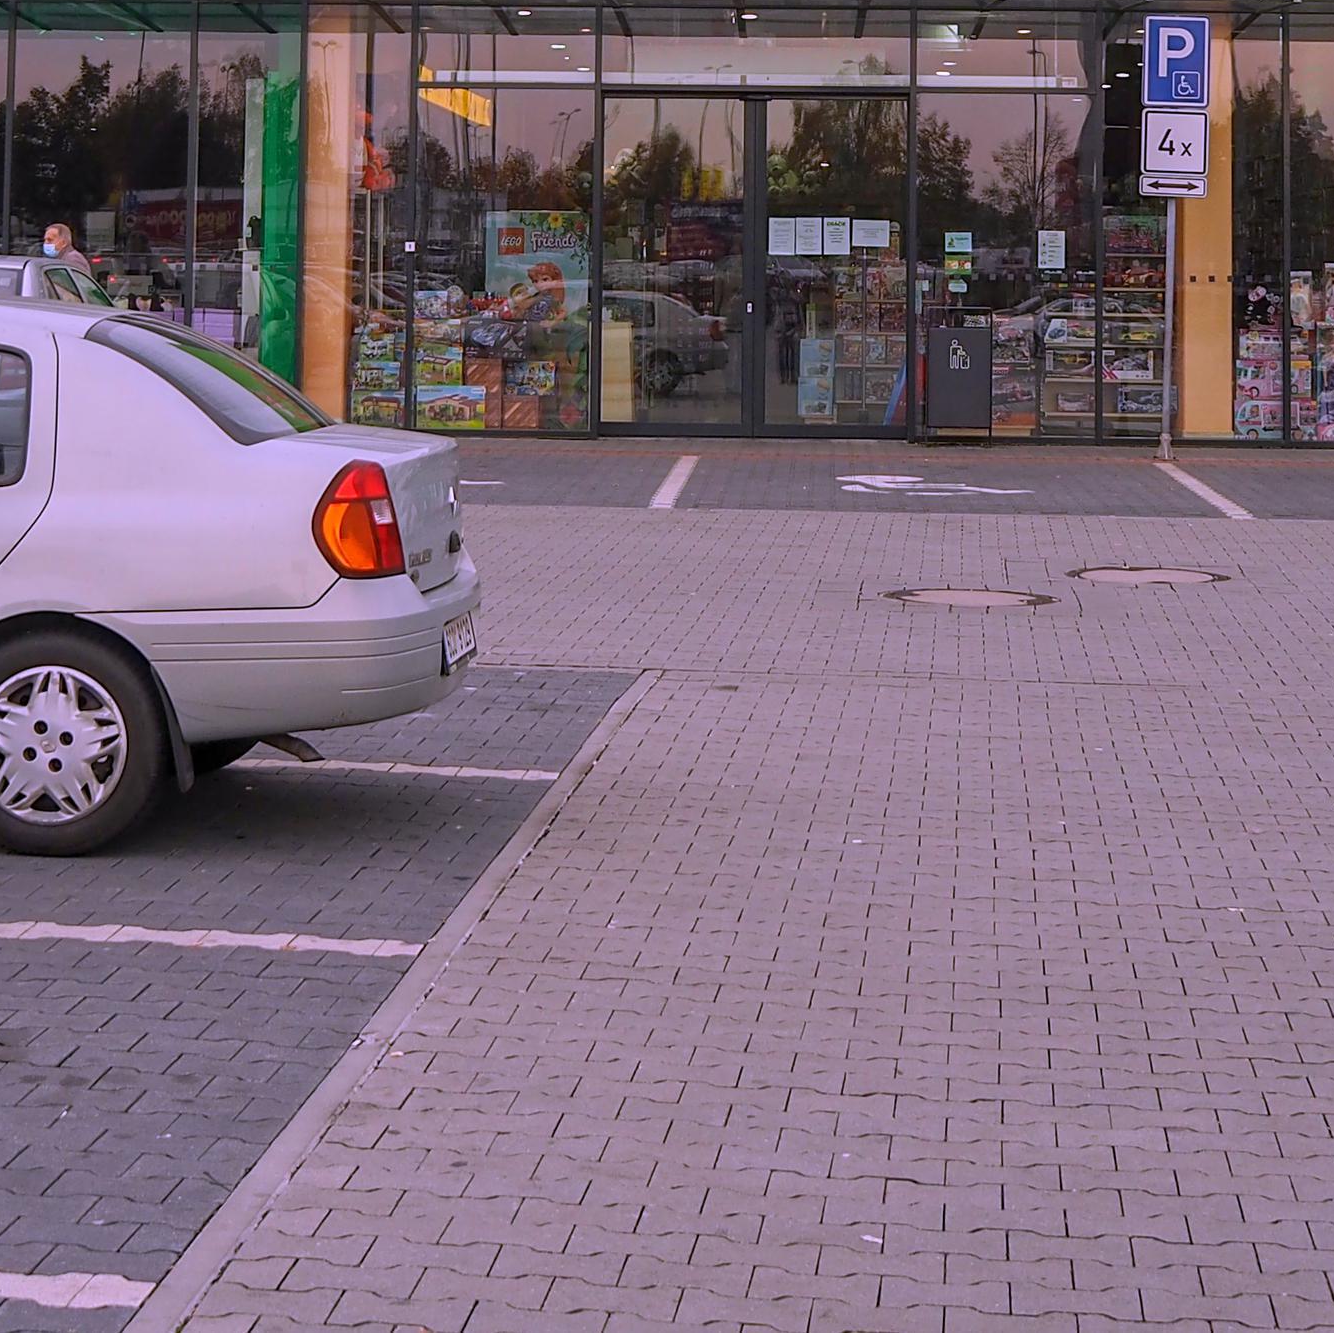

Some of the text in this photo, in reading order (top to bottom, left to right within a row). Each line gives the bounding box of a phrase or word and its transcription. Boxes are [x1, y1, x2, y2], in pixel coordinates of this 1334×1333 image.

[1157, 26, 1195, 78] P
[1157, 128, 1176, 156] 4
[500, 230, 578, 252] LEGO Friends
